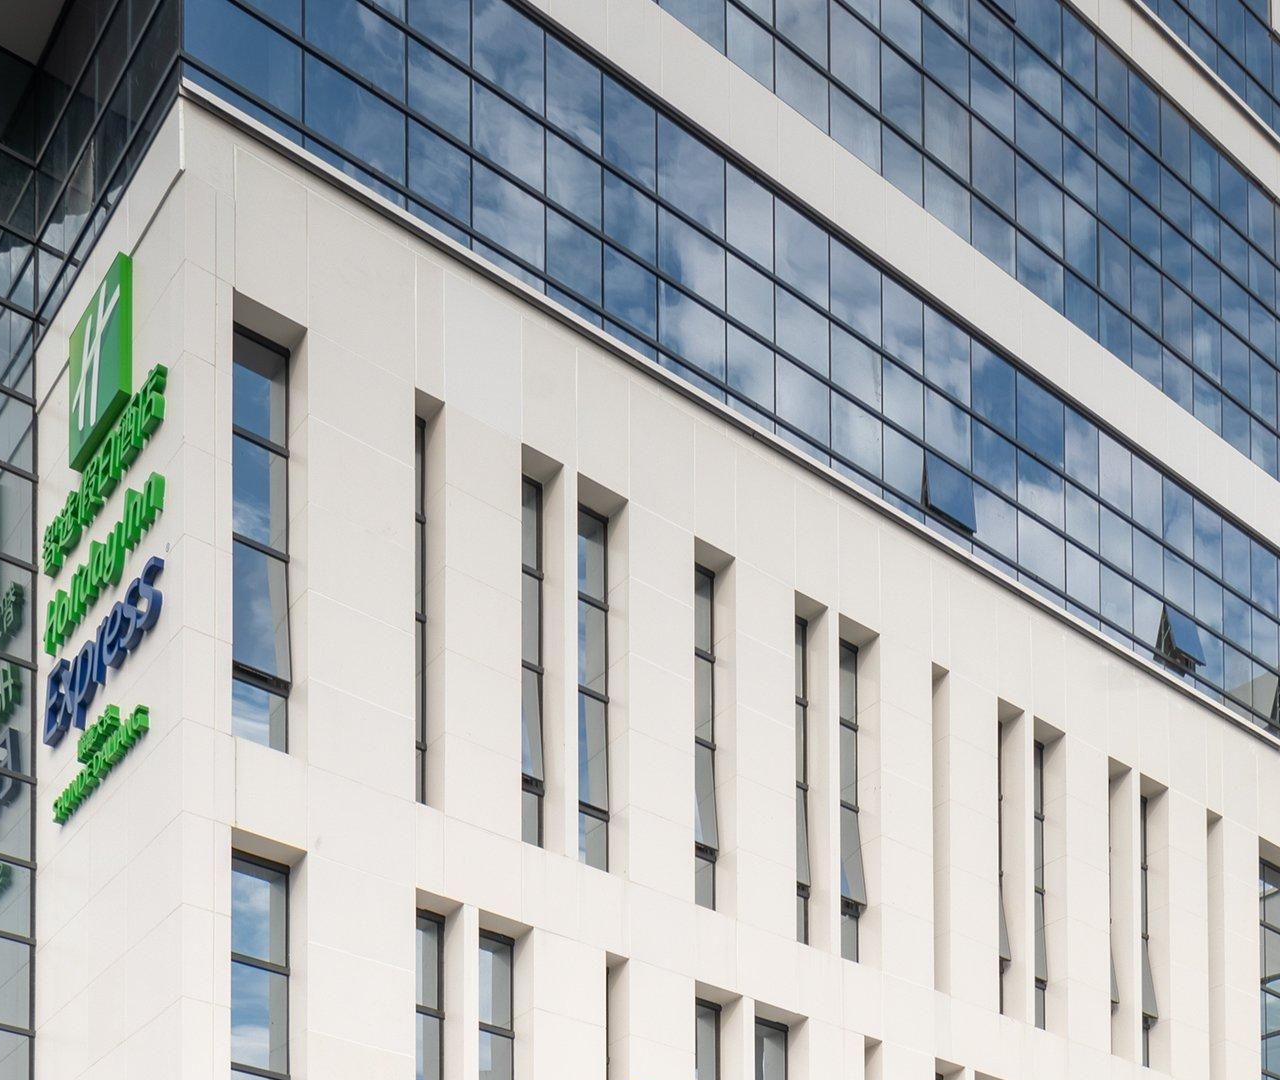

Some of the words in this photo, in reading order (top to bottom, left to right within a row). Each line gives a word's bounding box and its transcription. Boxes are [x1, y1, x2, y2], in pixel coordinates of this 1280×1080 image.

[43, 363, 168, 578] 智选假日酒店
[43, 521, 126, 656] Holiday
[121, 472, 166, 551] Inn
[43, 556, 164, 748] Express
